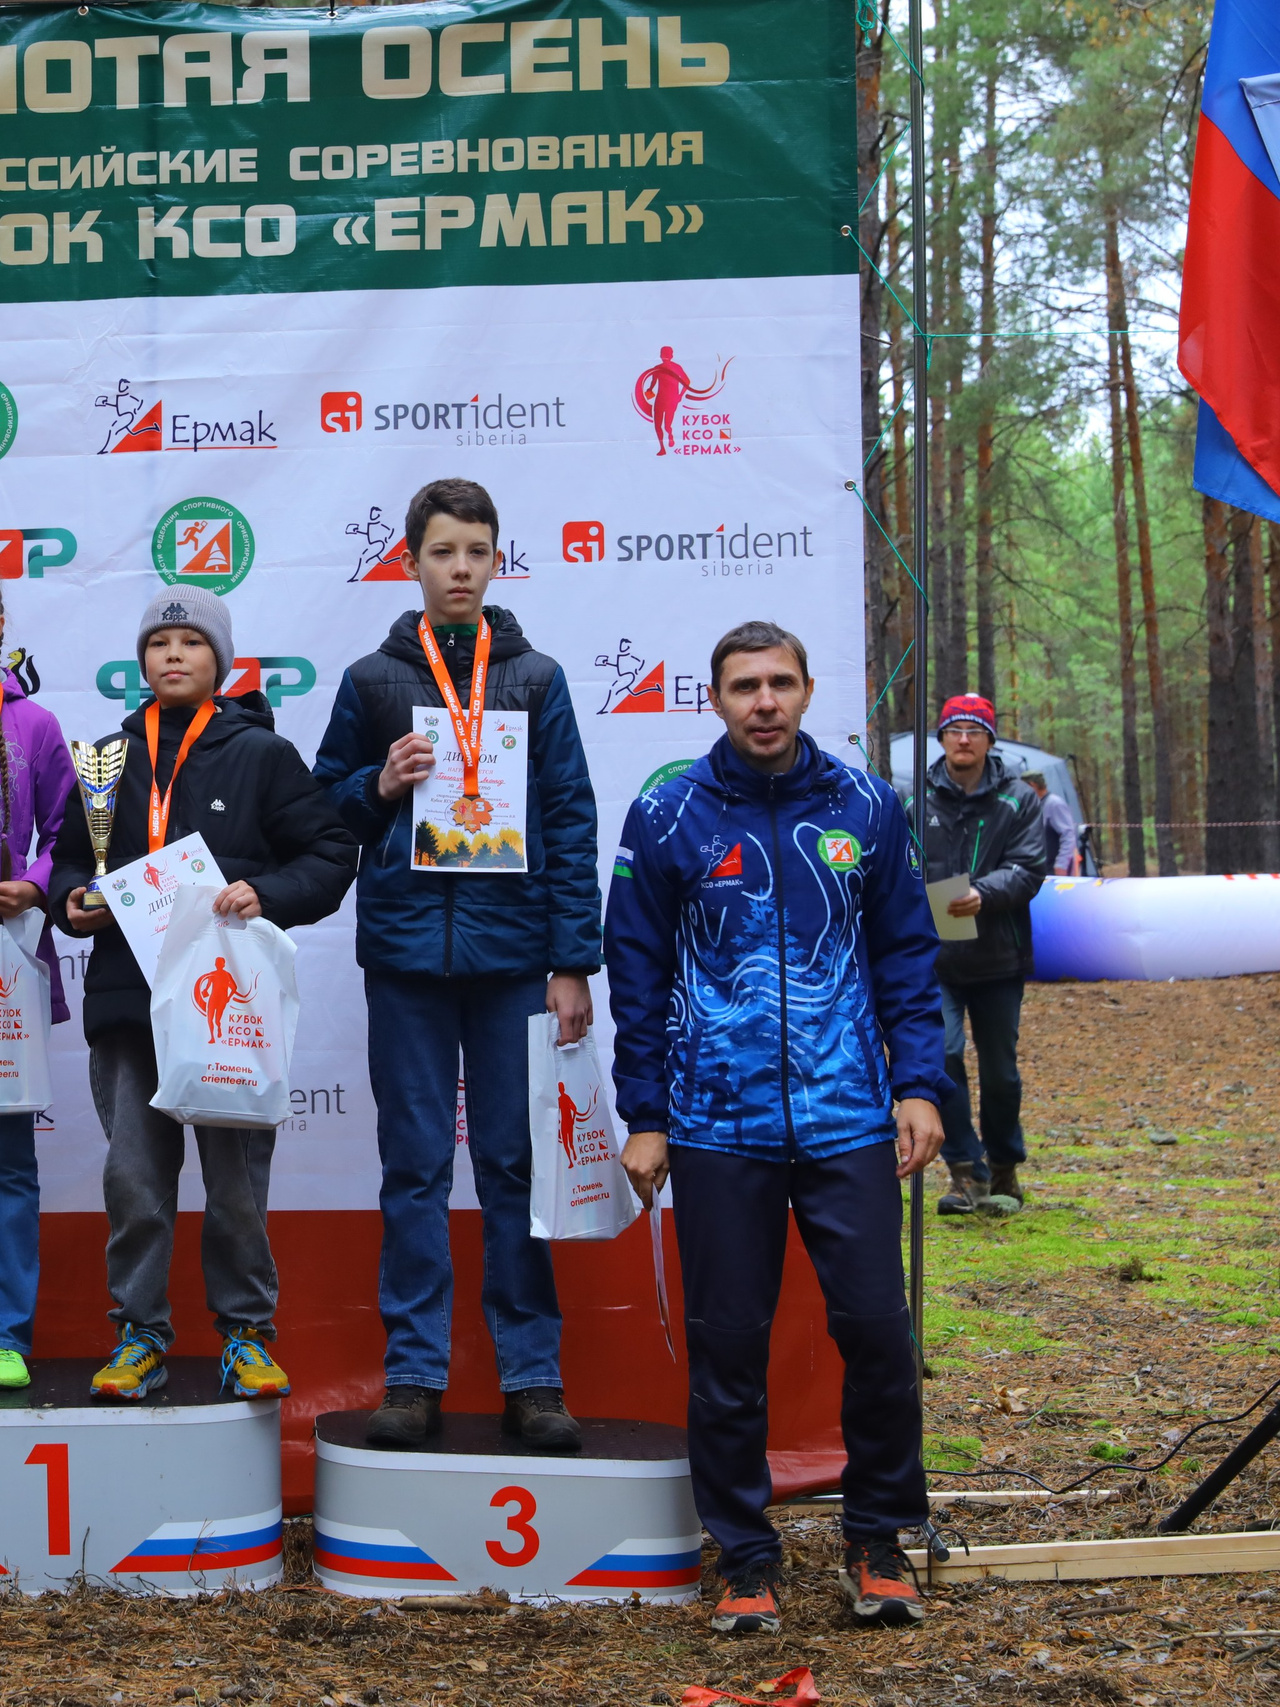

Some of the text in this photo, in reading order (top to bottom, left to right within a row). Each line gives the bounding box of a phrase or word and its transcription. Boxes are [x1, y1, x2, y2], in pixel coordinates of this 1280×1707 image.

[361, 15, 730, 100] ОСЕНЬ
[288, 130, 704, 182] СОРЕВНОВАНИЯ
[138, 203, 296, 260] КСО
[332, 188, 705, 252] «ЕРМАК»
[374, 393, 566, 431] SPORTident
[682, 414, 731, 426] КУБОК
[172, 410, 277, 452] Ермак
[456, 430, 527, 446] siberia
[682, 429, 713, 441] КСО
[673, 443, 742, 456] «ЕРМАК»
[156, 510, 179, 550] ФЕДЕРАЦИЯ
[182, 501, 234, 517] СПОРТИВНОГО
[230, 520, 250, 583] ОРИЕНТИРОВАНИЯ
[617, 522, 814, 562] SPORTident
[701, 560, 774, 577] siberia
[162, 613, 188, 622] Kappa
[473, 699, 481, 717] КСО
[455, 719, 466, 736] КСО
[471, 719, 479, 748] КУБОК
[475, 801, 486, 812] 3
[152, 809, 160, 837] КУБОК
[229, 1013, 263, 1024] КУБОК
[228, 1026, 251, 1036] КСО
[220, 1037, 272, 1049] «ЕРМАК»
[207, 1062, 253, 1074] г.Тюмень
[201, 1074, 258, 1087] orienteer.ru
[577, 1129, 606, 1142] КУБОК
[579, 1143, 596, 1154] КСО
[577, 1152, 616, 1166] «ЕРМАК»
[572, 1181, 603, 1195] г.Тюмень
[570, 1191, 610, 1207] orienteer.ru
[24, 1442, 71, 1556] 1
[485, 1484, 541, 1568] 3
